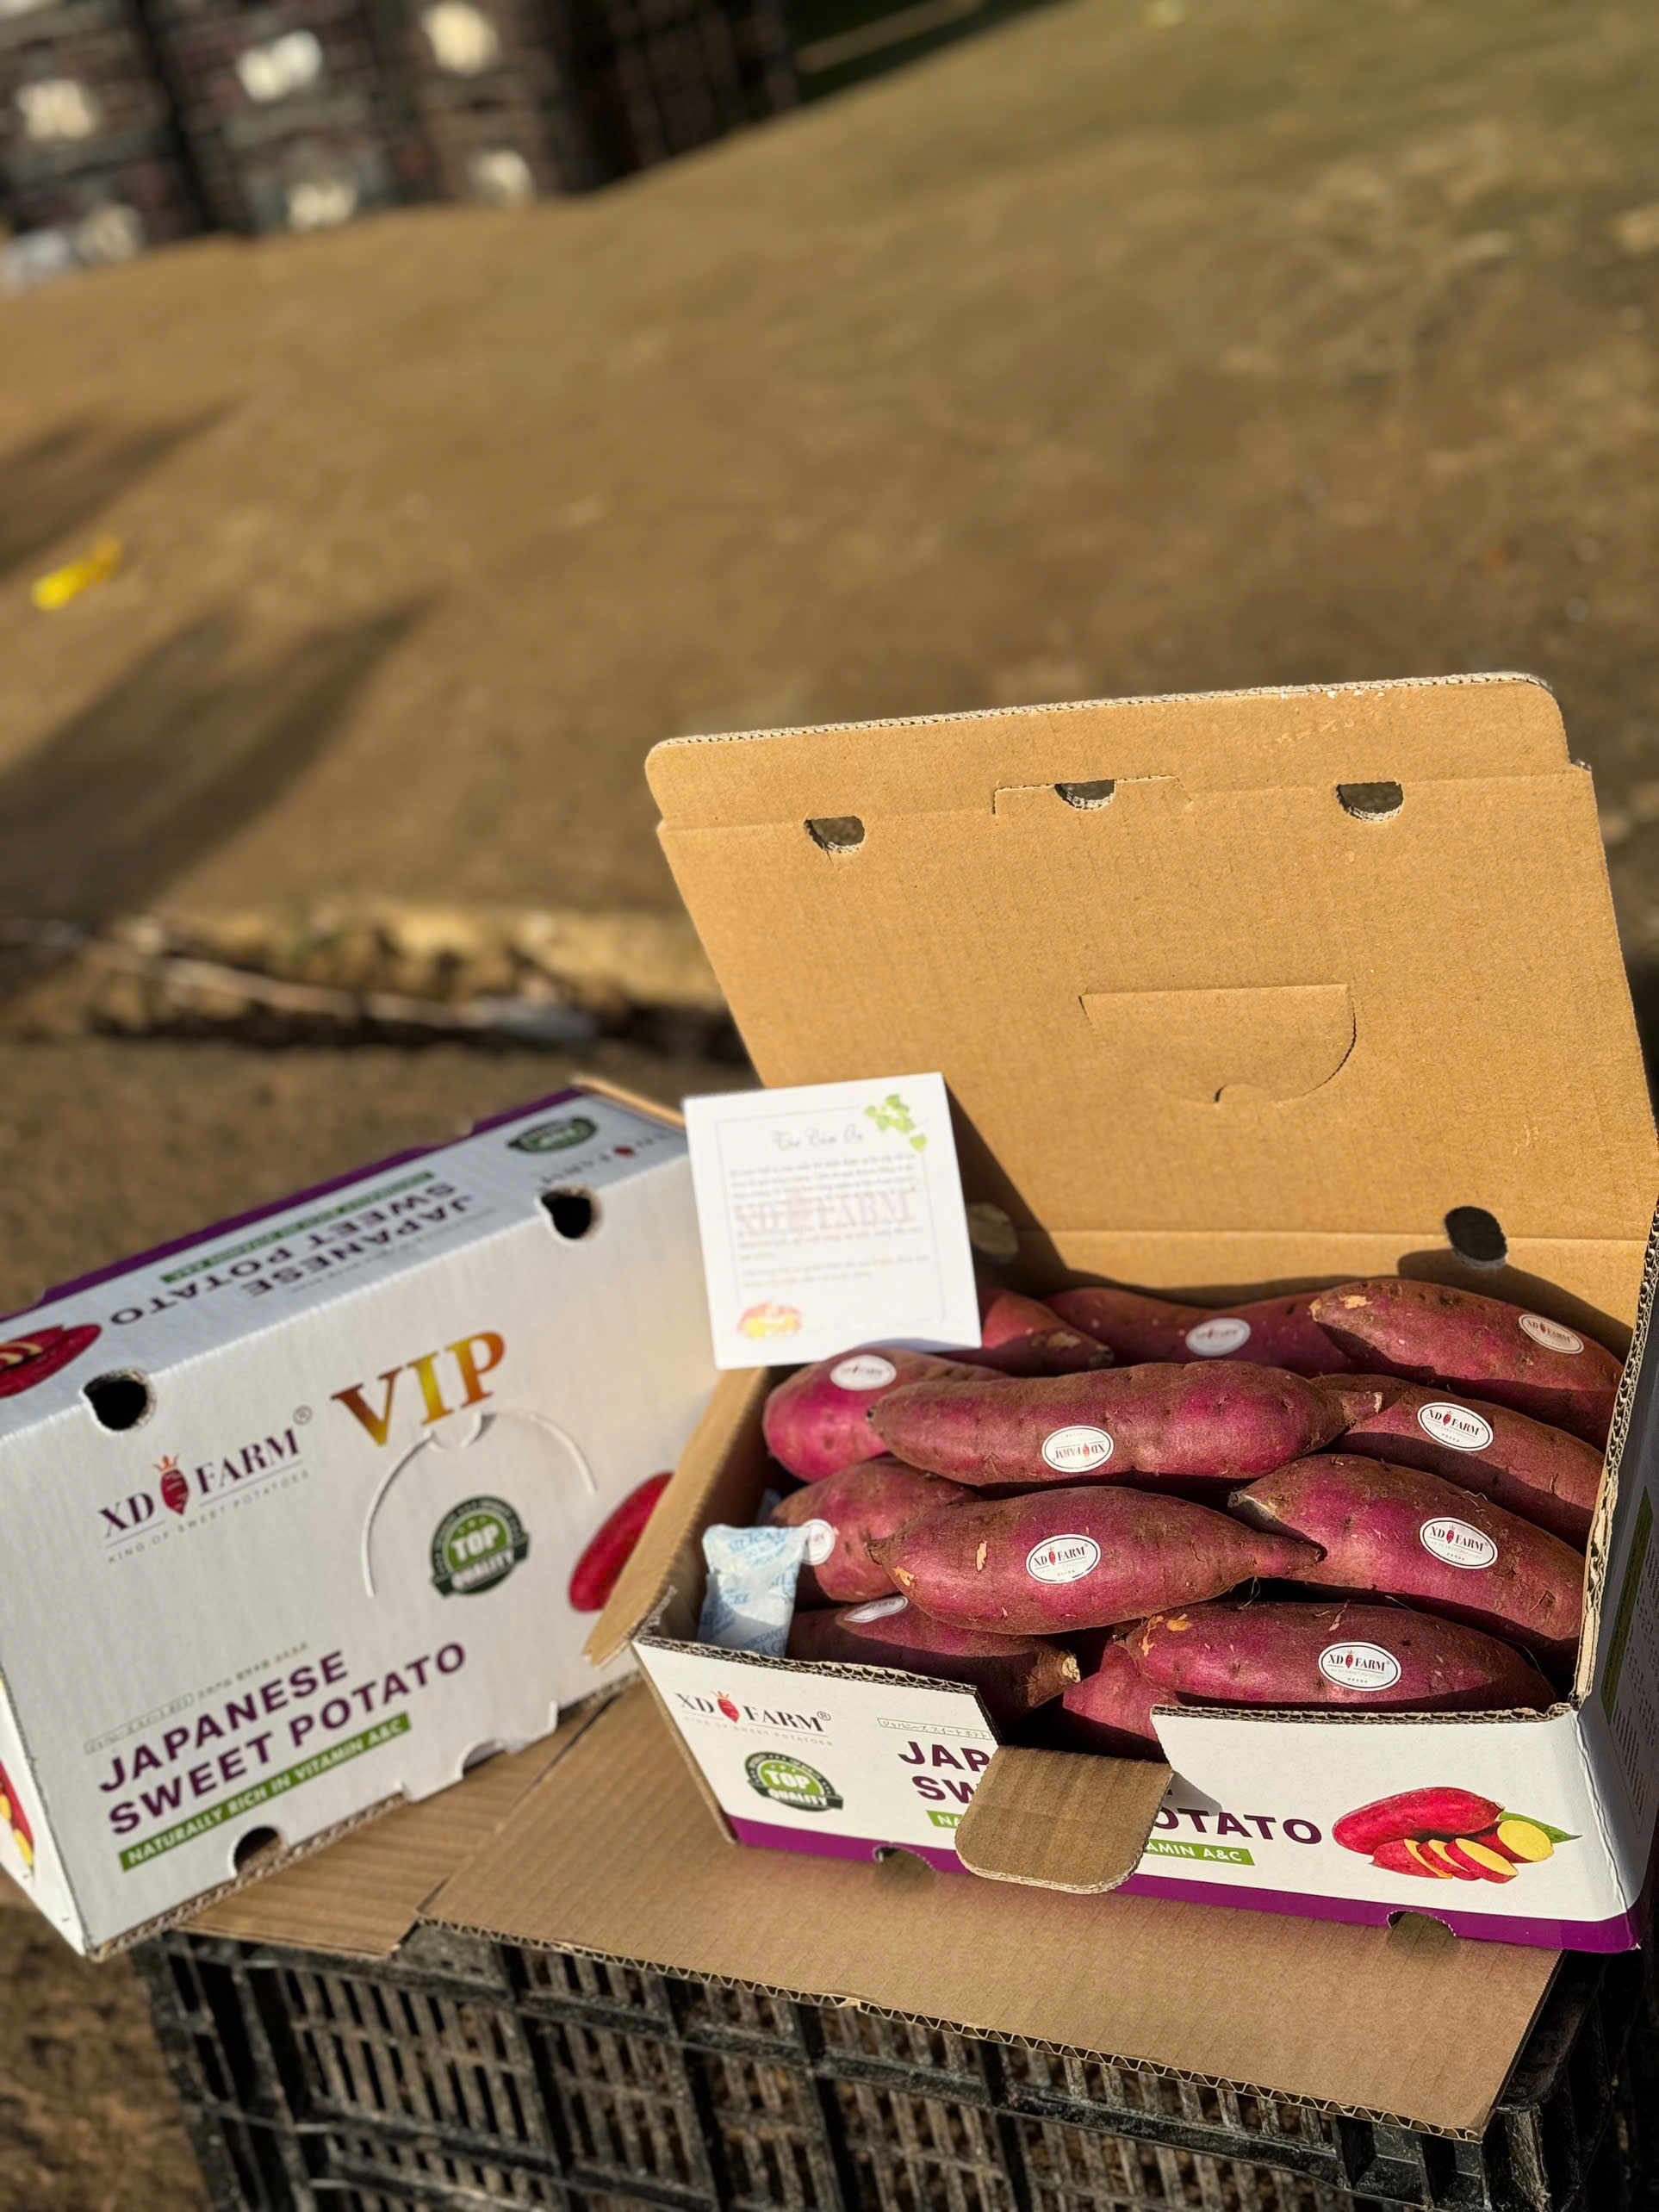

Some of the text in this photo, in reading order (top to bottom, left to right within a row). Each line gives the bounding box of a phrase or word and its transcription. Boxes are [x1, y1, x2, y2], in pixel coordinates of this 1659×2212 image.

[309, 1181, 457, 1246] SWEET
[242, 1194, 473, 1296] JAPANESE
[110, 1246, 293, 1325] POTATO
[331, 1331, 506, 1447] VIP
[1451, 1418, 1479, 1436] FARM
[98, 1427, 300, 1538] XD FARM
[177, 1505, 225, 1533] SWEET
[1429, 1525, 1445, 1538] XD
[1455, 1534, 1483, 1552] FARM
[450, 1523, 500, 1563] TOP
[1034, 1546, 1085, 1567] XD FARM
[452, 1549, 514, 1590] QUALITY
[1327, 1654, 1385, 1672] XD FARM
[99, 1650, 348, 1793] JAPANESE
[675, 1692, 824, 1732] XD FARM
[109, 1730, 272, 1835] SWEET
[289, 1641, 466, 1748] POTATO
[128, 1718, 403, 1866] NATURALLY RICH IN VITAMIN A&C
[764, 1769, 811, 1789] TOP
[767, 1788, 827, 1806] QUALITY
[1154, 1807, 1322, 1845] OTATO
[1146, 1842, 1243, 1861] AMIN A&C
